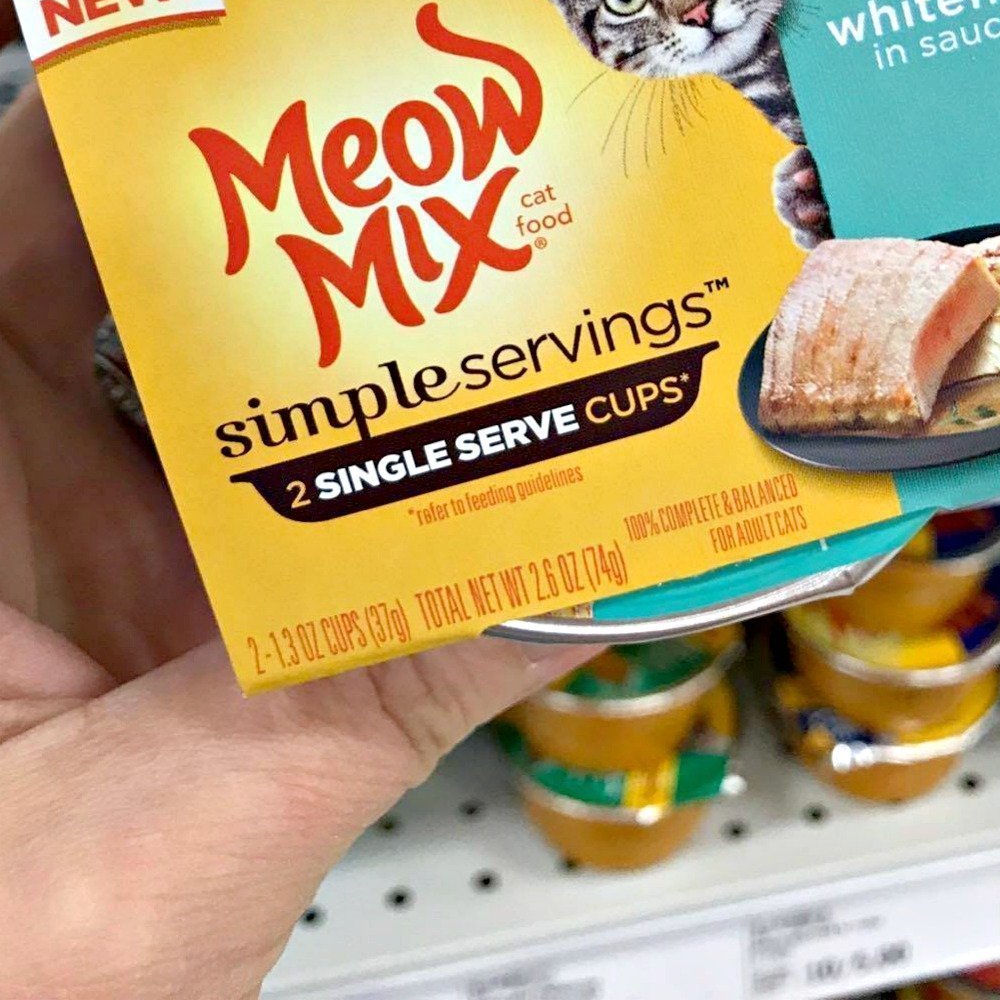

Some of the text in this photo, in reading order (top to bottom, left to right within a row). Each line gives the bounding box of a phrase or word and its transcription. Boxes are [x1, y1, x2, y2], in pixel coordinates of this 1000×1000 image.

[873, 43, 908, 71] in
[516, 203, 573, 237] food
[521, 184, 556, 208] cat
[285, 481, 311, 509] 2
[315, 438, 453, 500] SINGLE
[455, 404, 580, 462] SERVE
[450, 499, 465, 517] to
[465, 484, 516, 516] feeding
[517, 466, 584, 502] guidelines
[623, 472, 799, 542] 100% COMPLETE & BALANCED
[710, 505, 808, 554] FOR ADULT CATS
[299, 621, 323, 661] OZ
[321, 608, 368, 656] CUPS
[364, 598, 412, 647] (37g)
[415, 583, 472, 630] TOTAL
[467, 573, 502, 617] NET
[500, 565, 530, 608] WT
[528, 557, 559, 601] 2.6
[562, 552, 584, 592] OZ
[582, 540, 628, 592] (74g)
